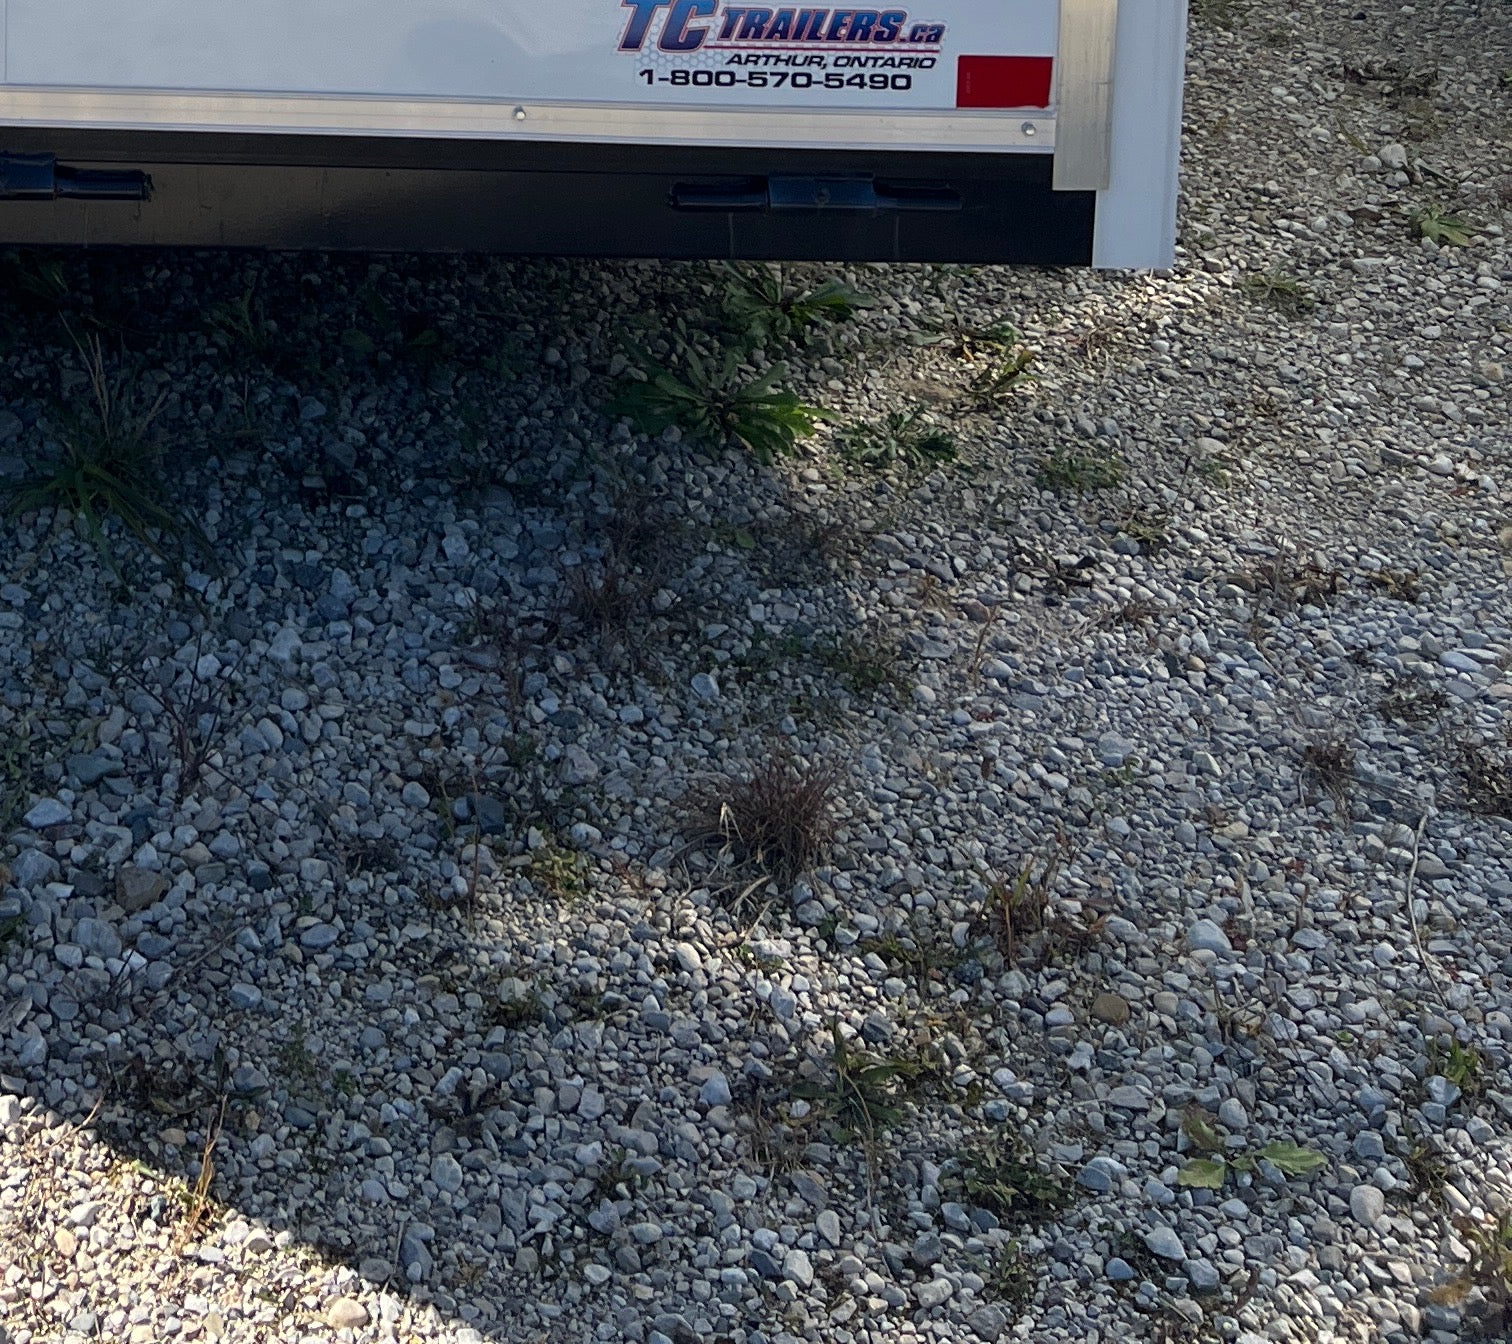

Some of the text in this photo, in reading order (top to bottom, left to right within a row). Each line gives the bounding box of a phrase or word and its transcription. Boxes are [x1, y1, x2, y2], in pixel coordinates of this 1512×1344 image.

[719, 6, 947, 45] TRAILERS.ca
[724, 53, 937, 70] ARTHUR, ONTARIO
[638, 69, 912, 91] 1-800-570-5490
